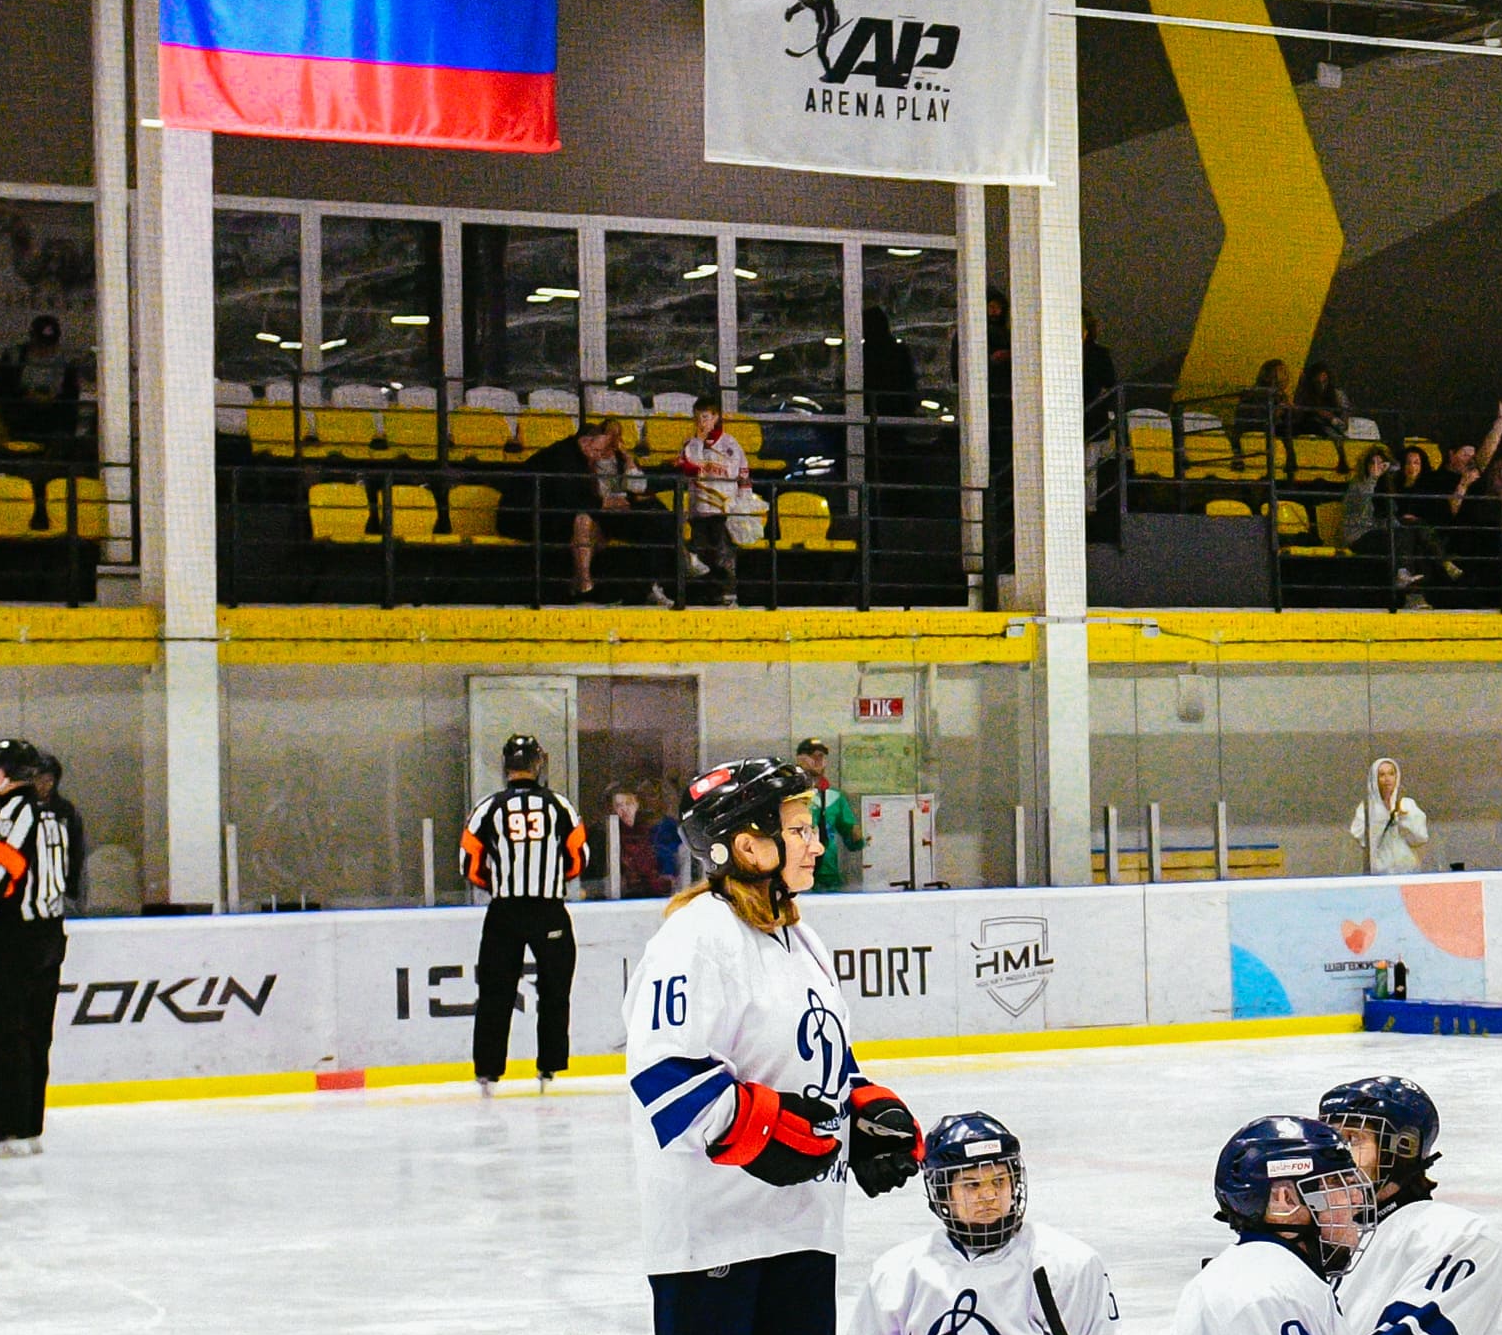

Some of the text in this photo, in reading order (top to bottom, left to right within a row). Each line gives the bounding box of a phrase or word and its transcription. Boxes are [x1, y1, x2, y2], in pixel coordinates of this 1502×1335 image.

[804, 87, 951, 123] ARENA PLAY
[869, 699, 893, 717] ПК
[506, 810, 545, 842] 93
[975, 941, 1055, 979] HML
[651, 973, 688, 1032] 16
[1423, 1254, 1476, 1293] 10
